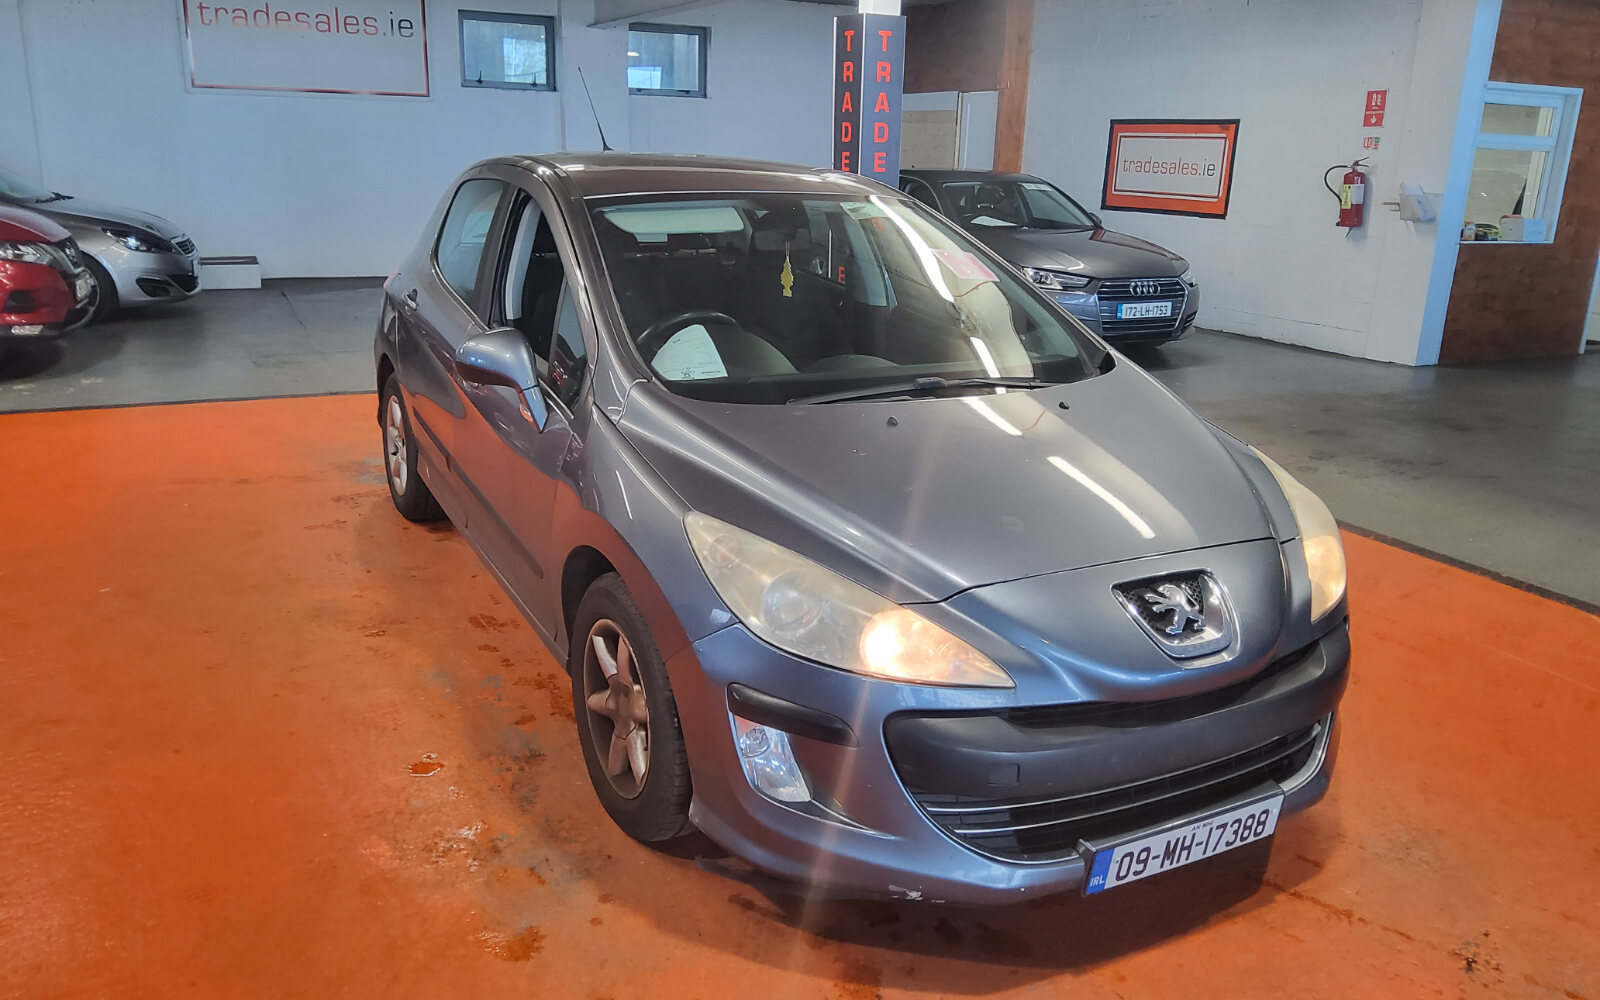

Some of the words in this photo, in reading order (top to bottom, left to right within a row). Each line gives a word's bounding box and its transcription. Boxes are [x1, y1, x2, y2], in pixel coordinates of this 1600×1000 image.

[197, 2, 414, 38] tradesales.ie
[841, 30, 855, 171] TRADE
[873, 30, 892, 173] TRADE
[1122, 156, 1217, 177] tradesales.ie
[1125, 305, 1168, 317] 172-LH-1753
[1115, 808, 1270, 882] 09-MH-17388
[1090, 875, 1105, 887] IRL
